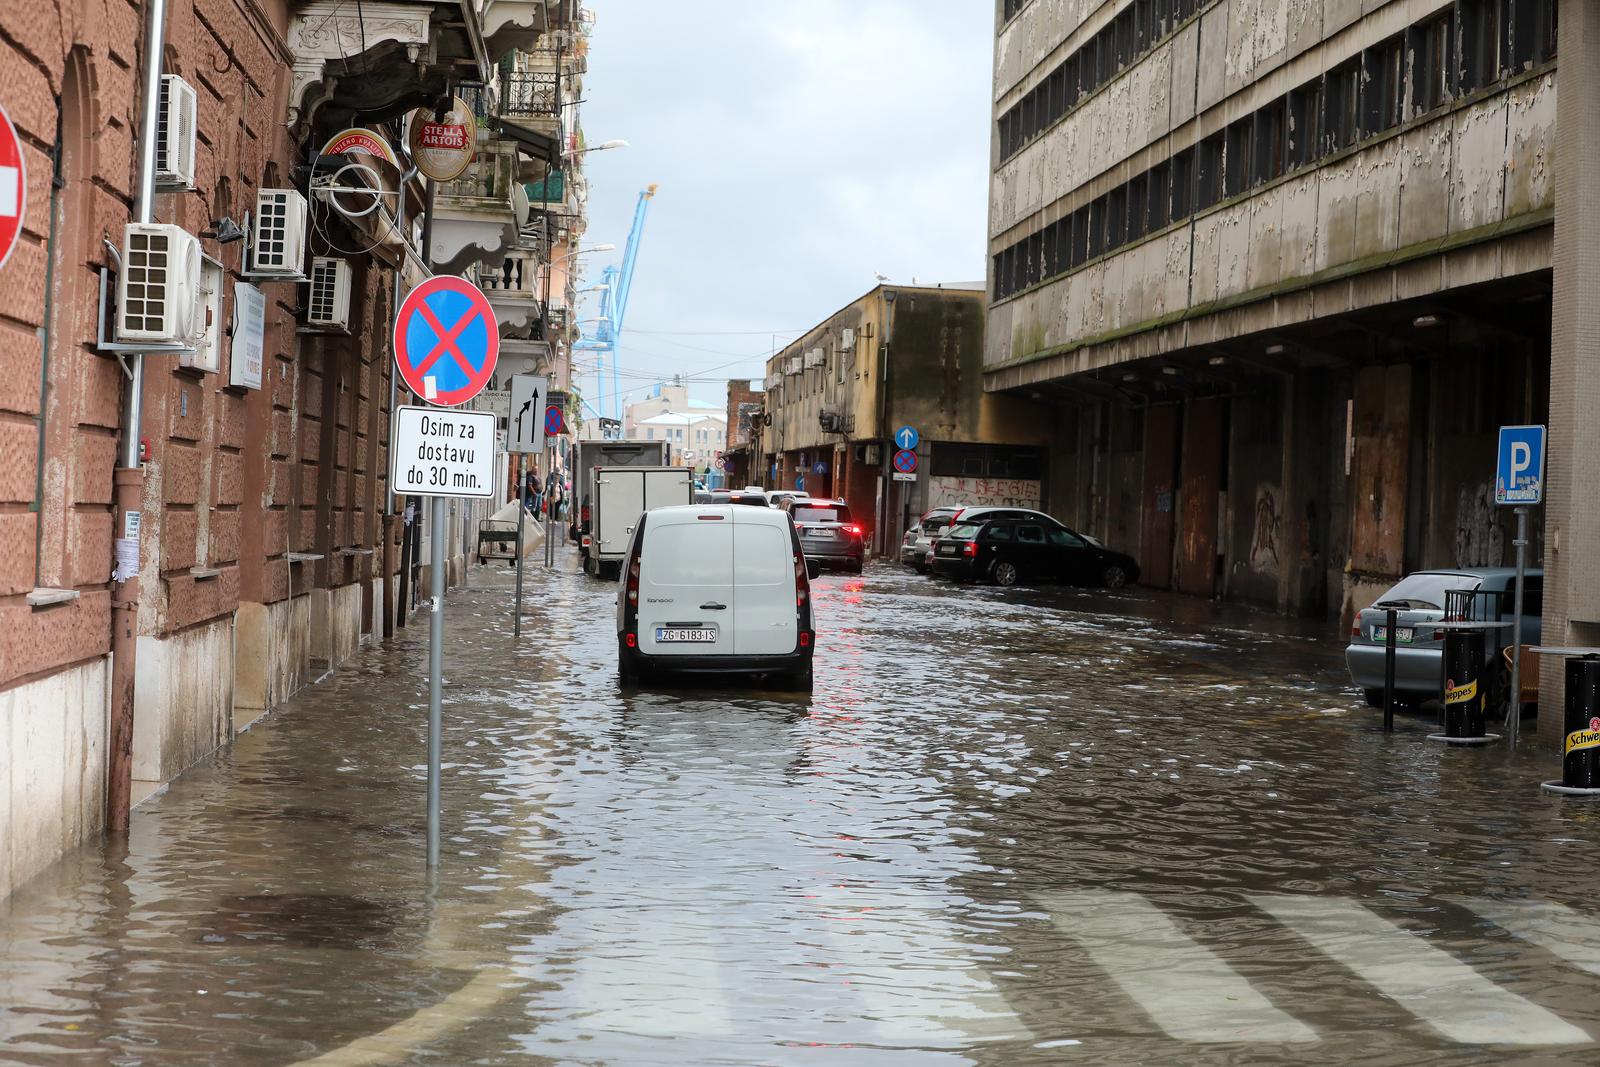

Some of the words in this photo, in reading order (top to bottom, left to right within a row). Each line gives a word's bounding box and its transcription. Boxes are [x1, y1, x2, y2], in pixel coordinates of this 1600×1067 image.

[424, 125, 463, 136] STELLA
[423, 135, 463, 146] ARTOIS
[421, 416, 453, 437] Osim
[460, 424, 475, 439] za
[418, 441, 474, 463] dostavu
[1510, 442, 1531, 488] P
[408, 465, 423, 484] do
[429, 466, 447, 486] 30
[454, 469, 481, 488] min.
[663, 631, 675, 640] ZG
[1570, 732, 1600, 747] Schwe
